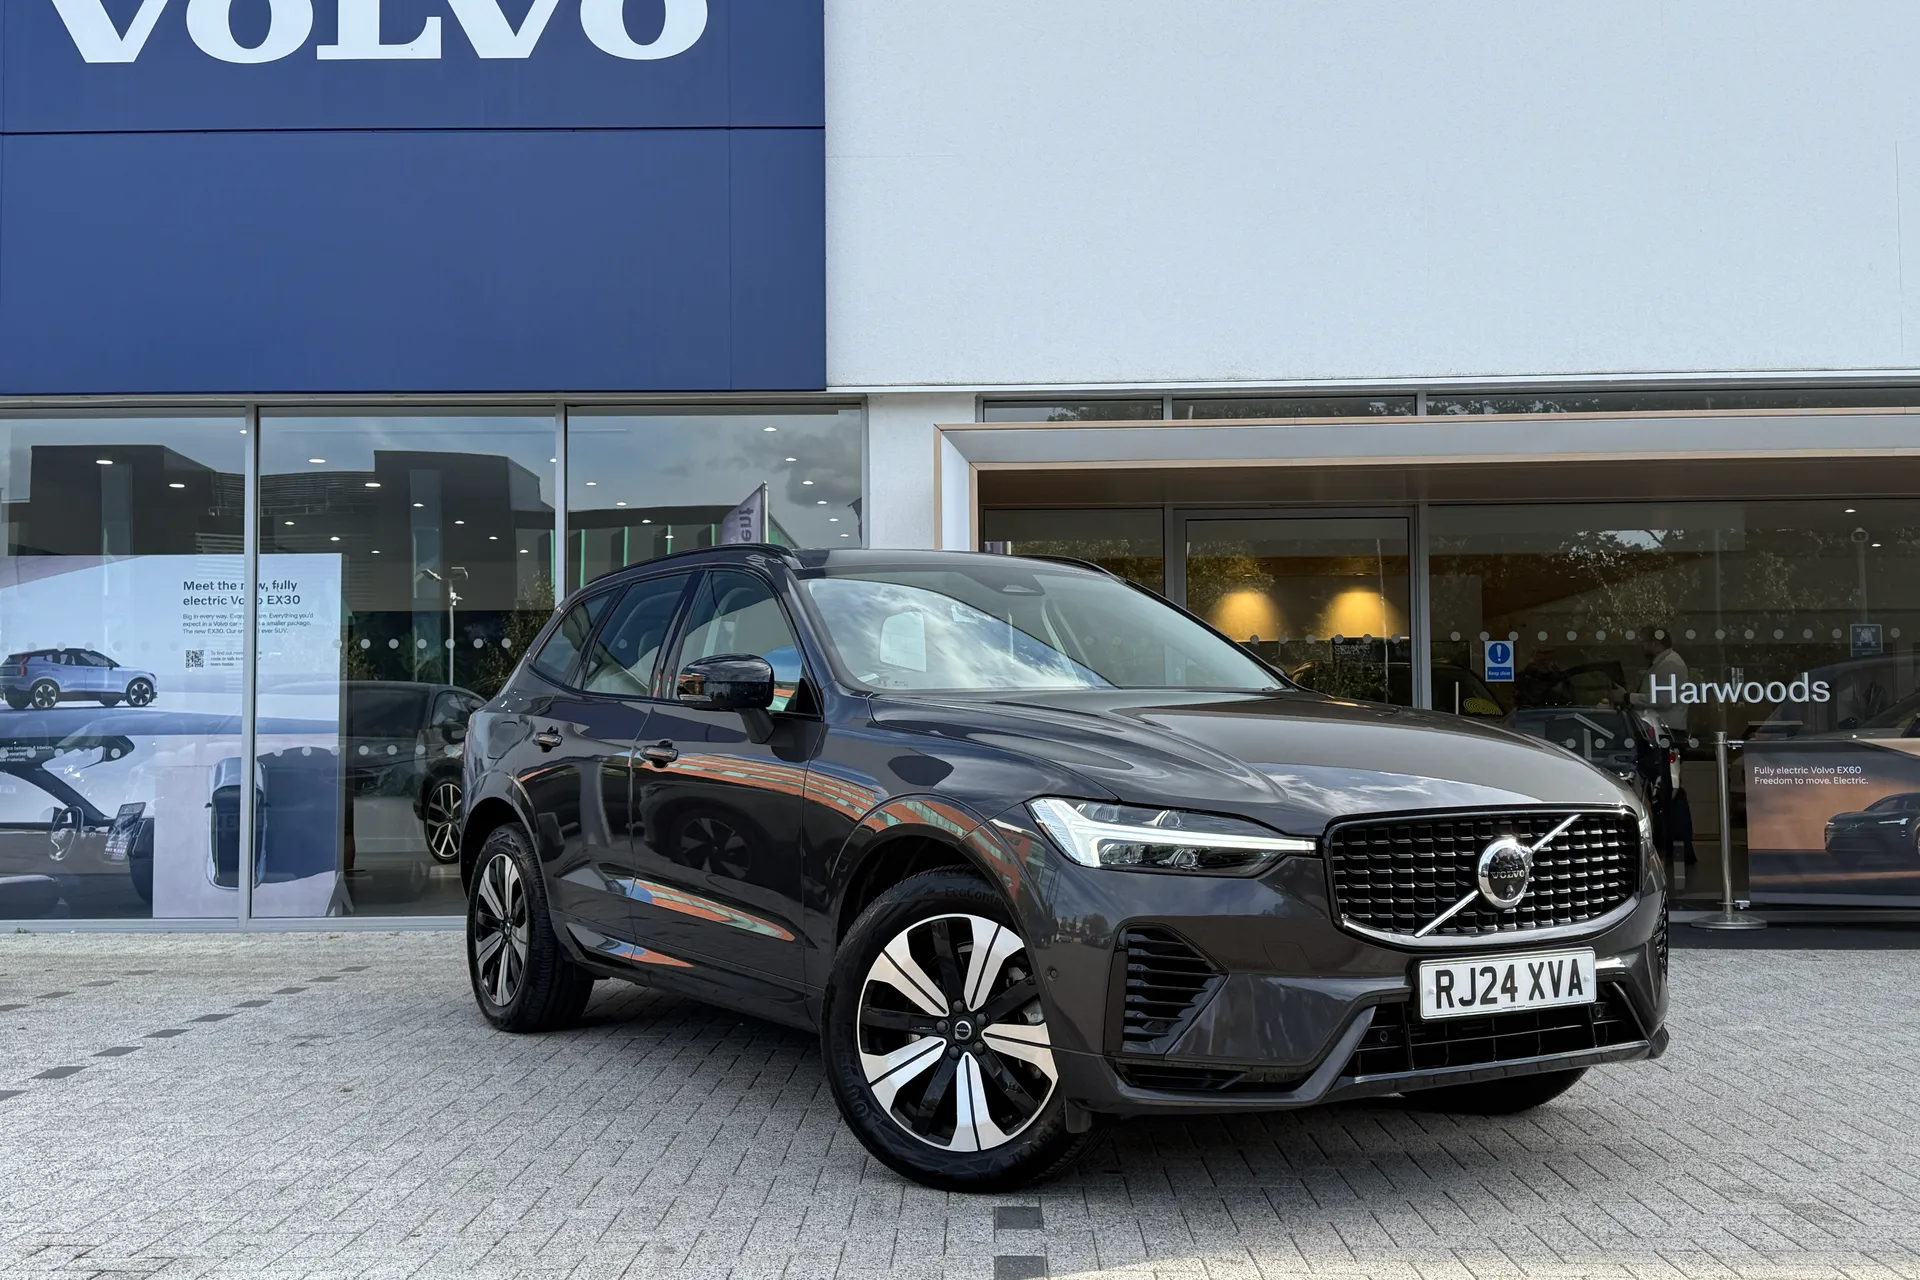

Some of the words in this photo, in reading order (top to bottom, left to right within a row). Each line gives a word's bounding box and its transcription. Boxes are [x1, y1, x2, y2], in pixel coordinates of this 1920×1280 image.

[51, 0, 709, 64] VOLVO
[183, 581, 215, 591] Meet
[217, 580, 237, 591] the
[272, 579, 298, 592] fully
[183, 595, 228, 606] electric
[230, 595, 264, 605] Voo
[267, 594, 301, 605] EX30
[1650, 672, 1831, 704] Harwoods
[1754, 766, 1774, 776] Fully
[1776, 766, 1809, 775] electric
[1810, 766, 1835, 775] Volvo
[1837, 766, 1862, 774] EX60
[1754, 777, 1793, 785] Freedom
[1794, 777, 1804, 785] to
[1833, 776, 1869, 785] Electric.
[1490, 869, 1525, 879] VOLVO
[1435, 964, 1519, 1009] RJ24
[1527, 958, 1584, 1001] XVA
